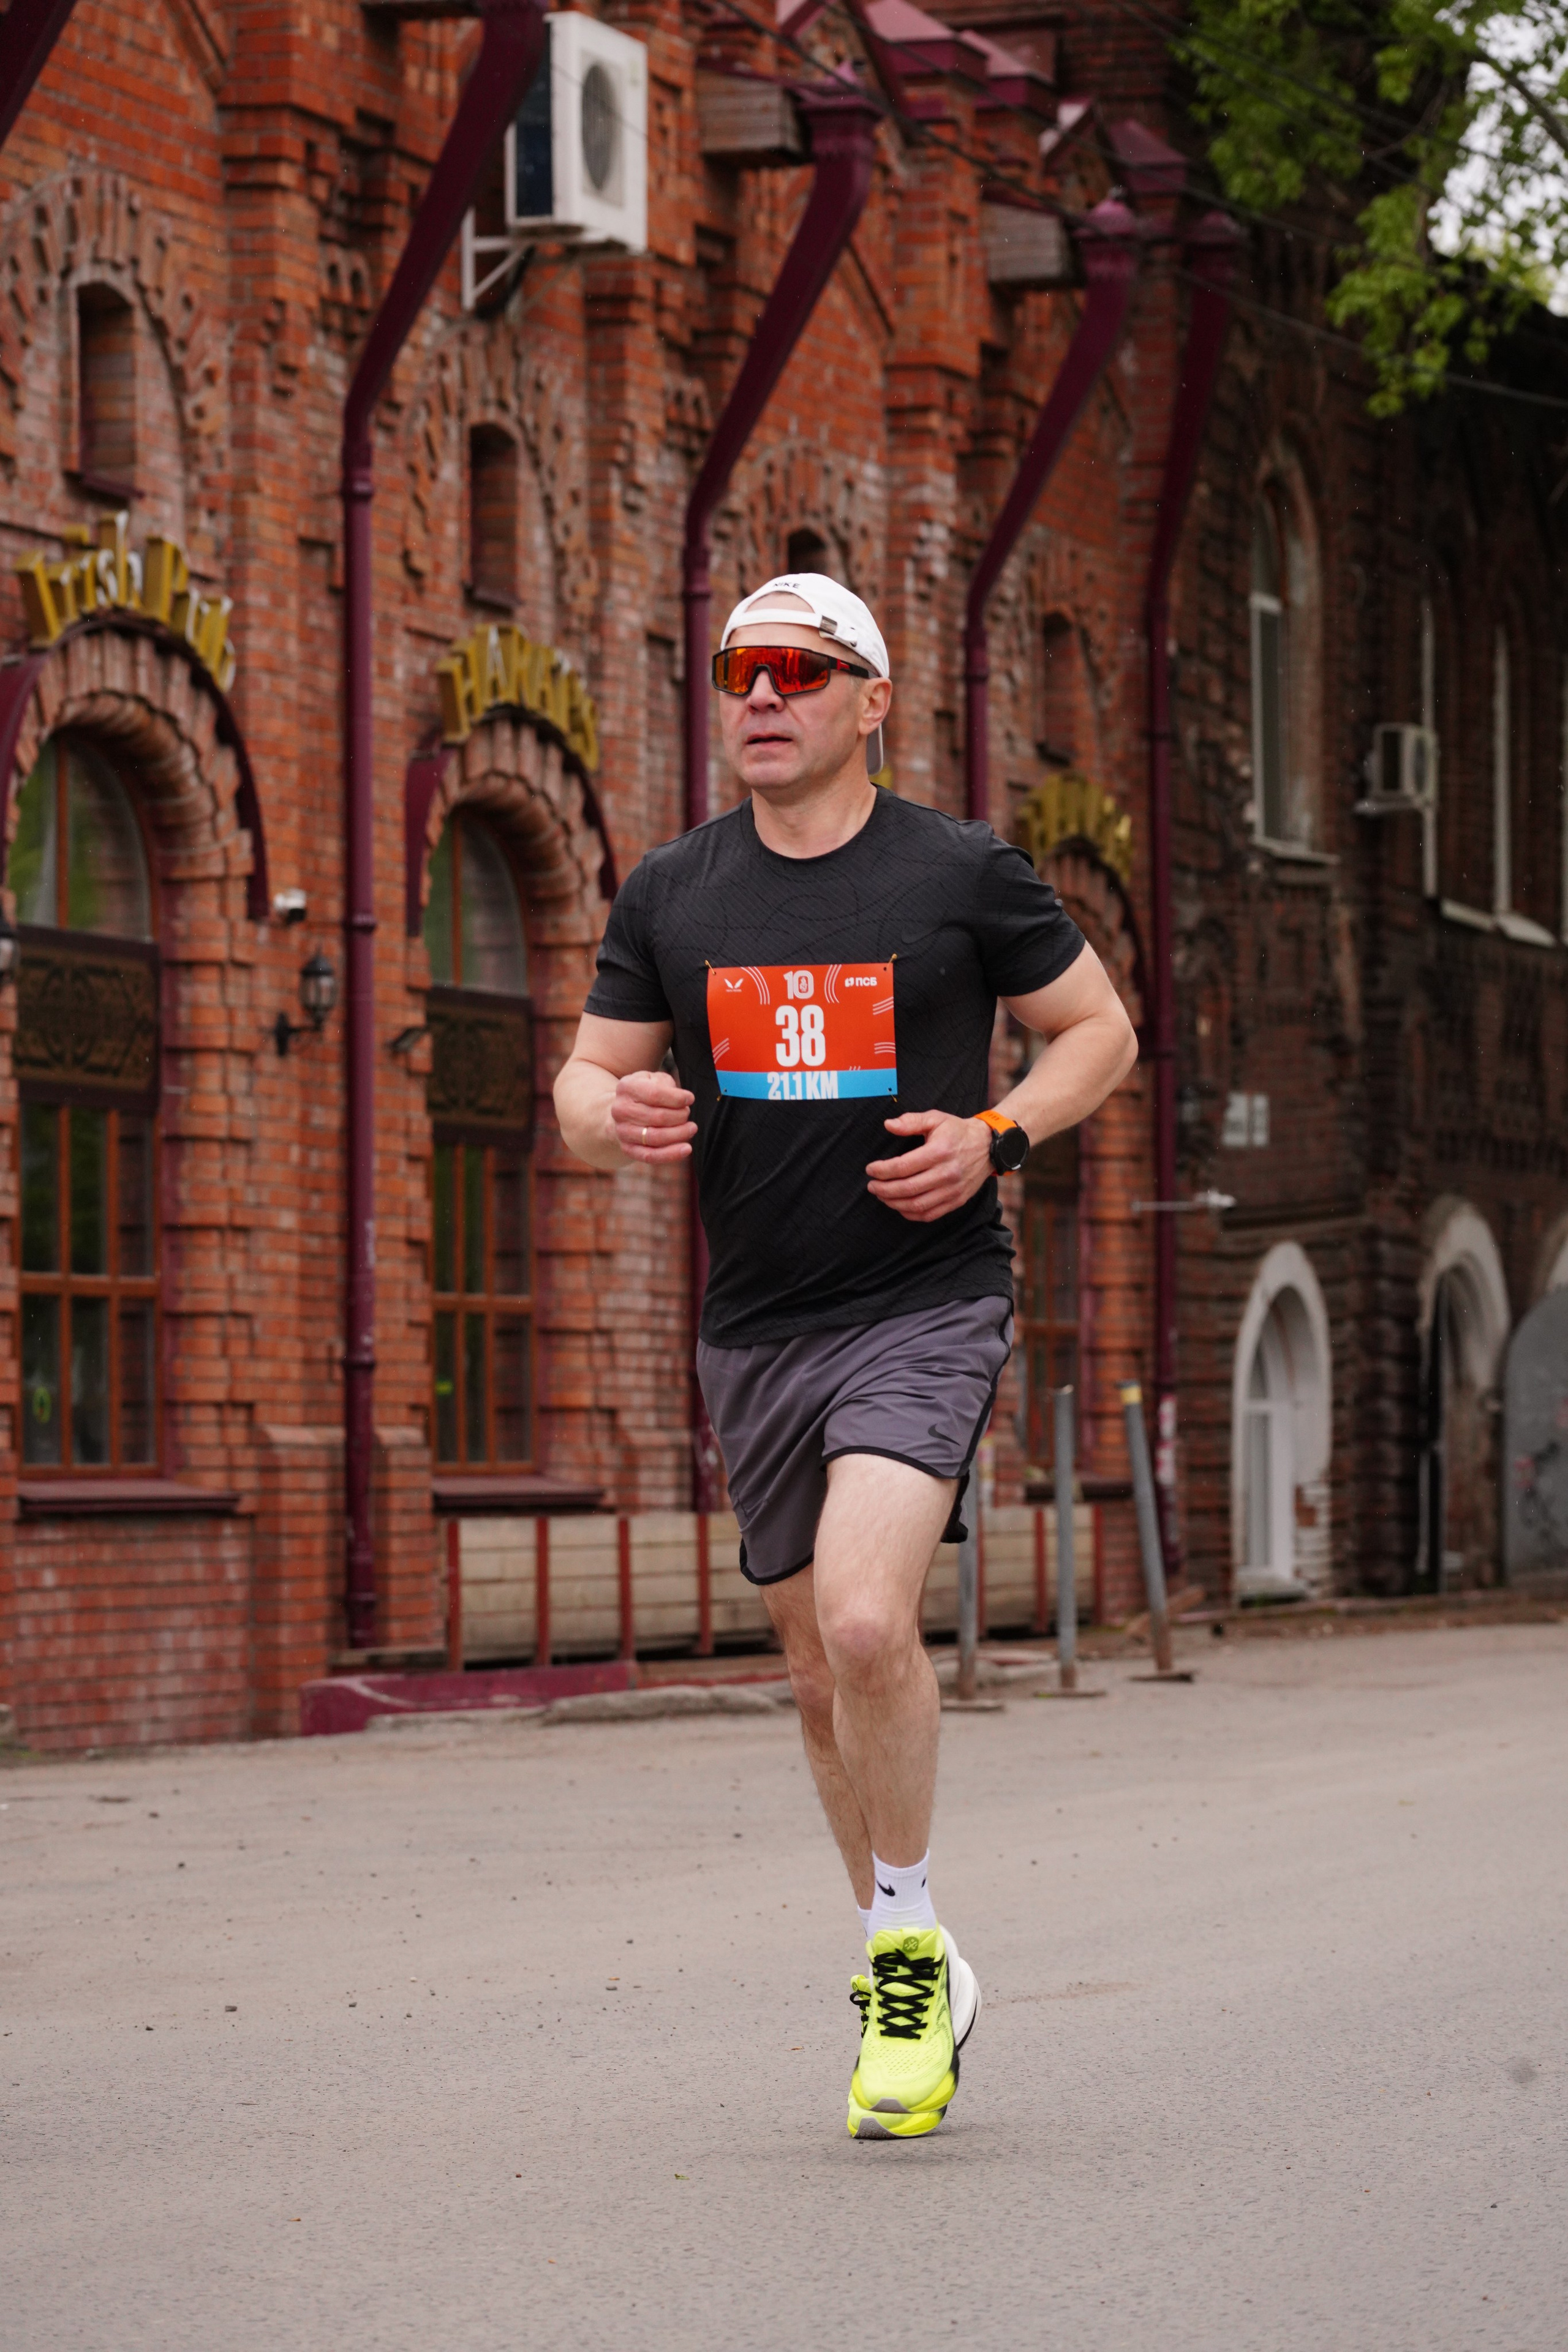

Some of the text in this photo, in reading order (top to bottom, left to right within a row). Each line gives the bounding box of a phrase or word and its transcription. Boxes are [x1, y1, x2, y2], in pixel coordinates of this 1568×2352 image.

[783, 970, 815, 1000] 10
[855, 976, 878, 987] ПСБ
[775, 1005, 826, 1067] 38
[767, 1071, 803, 1100] 21.1
